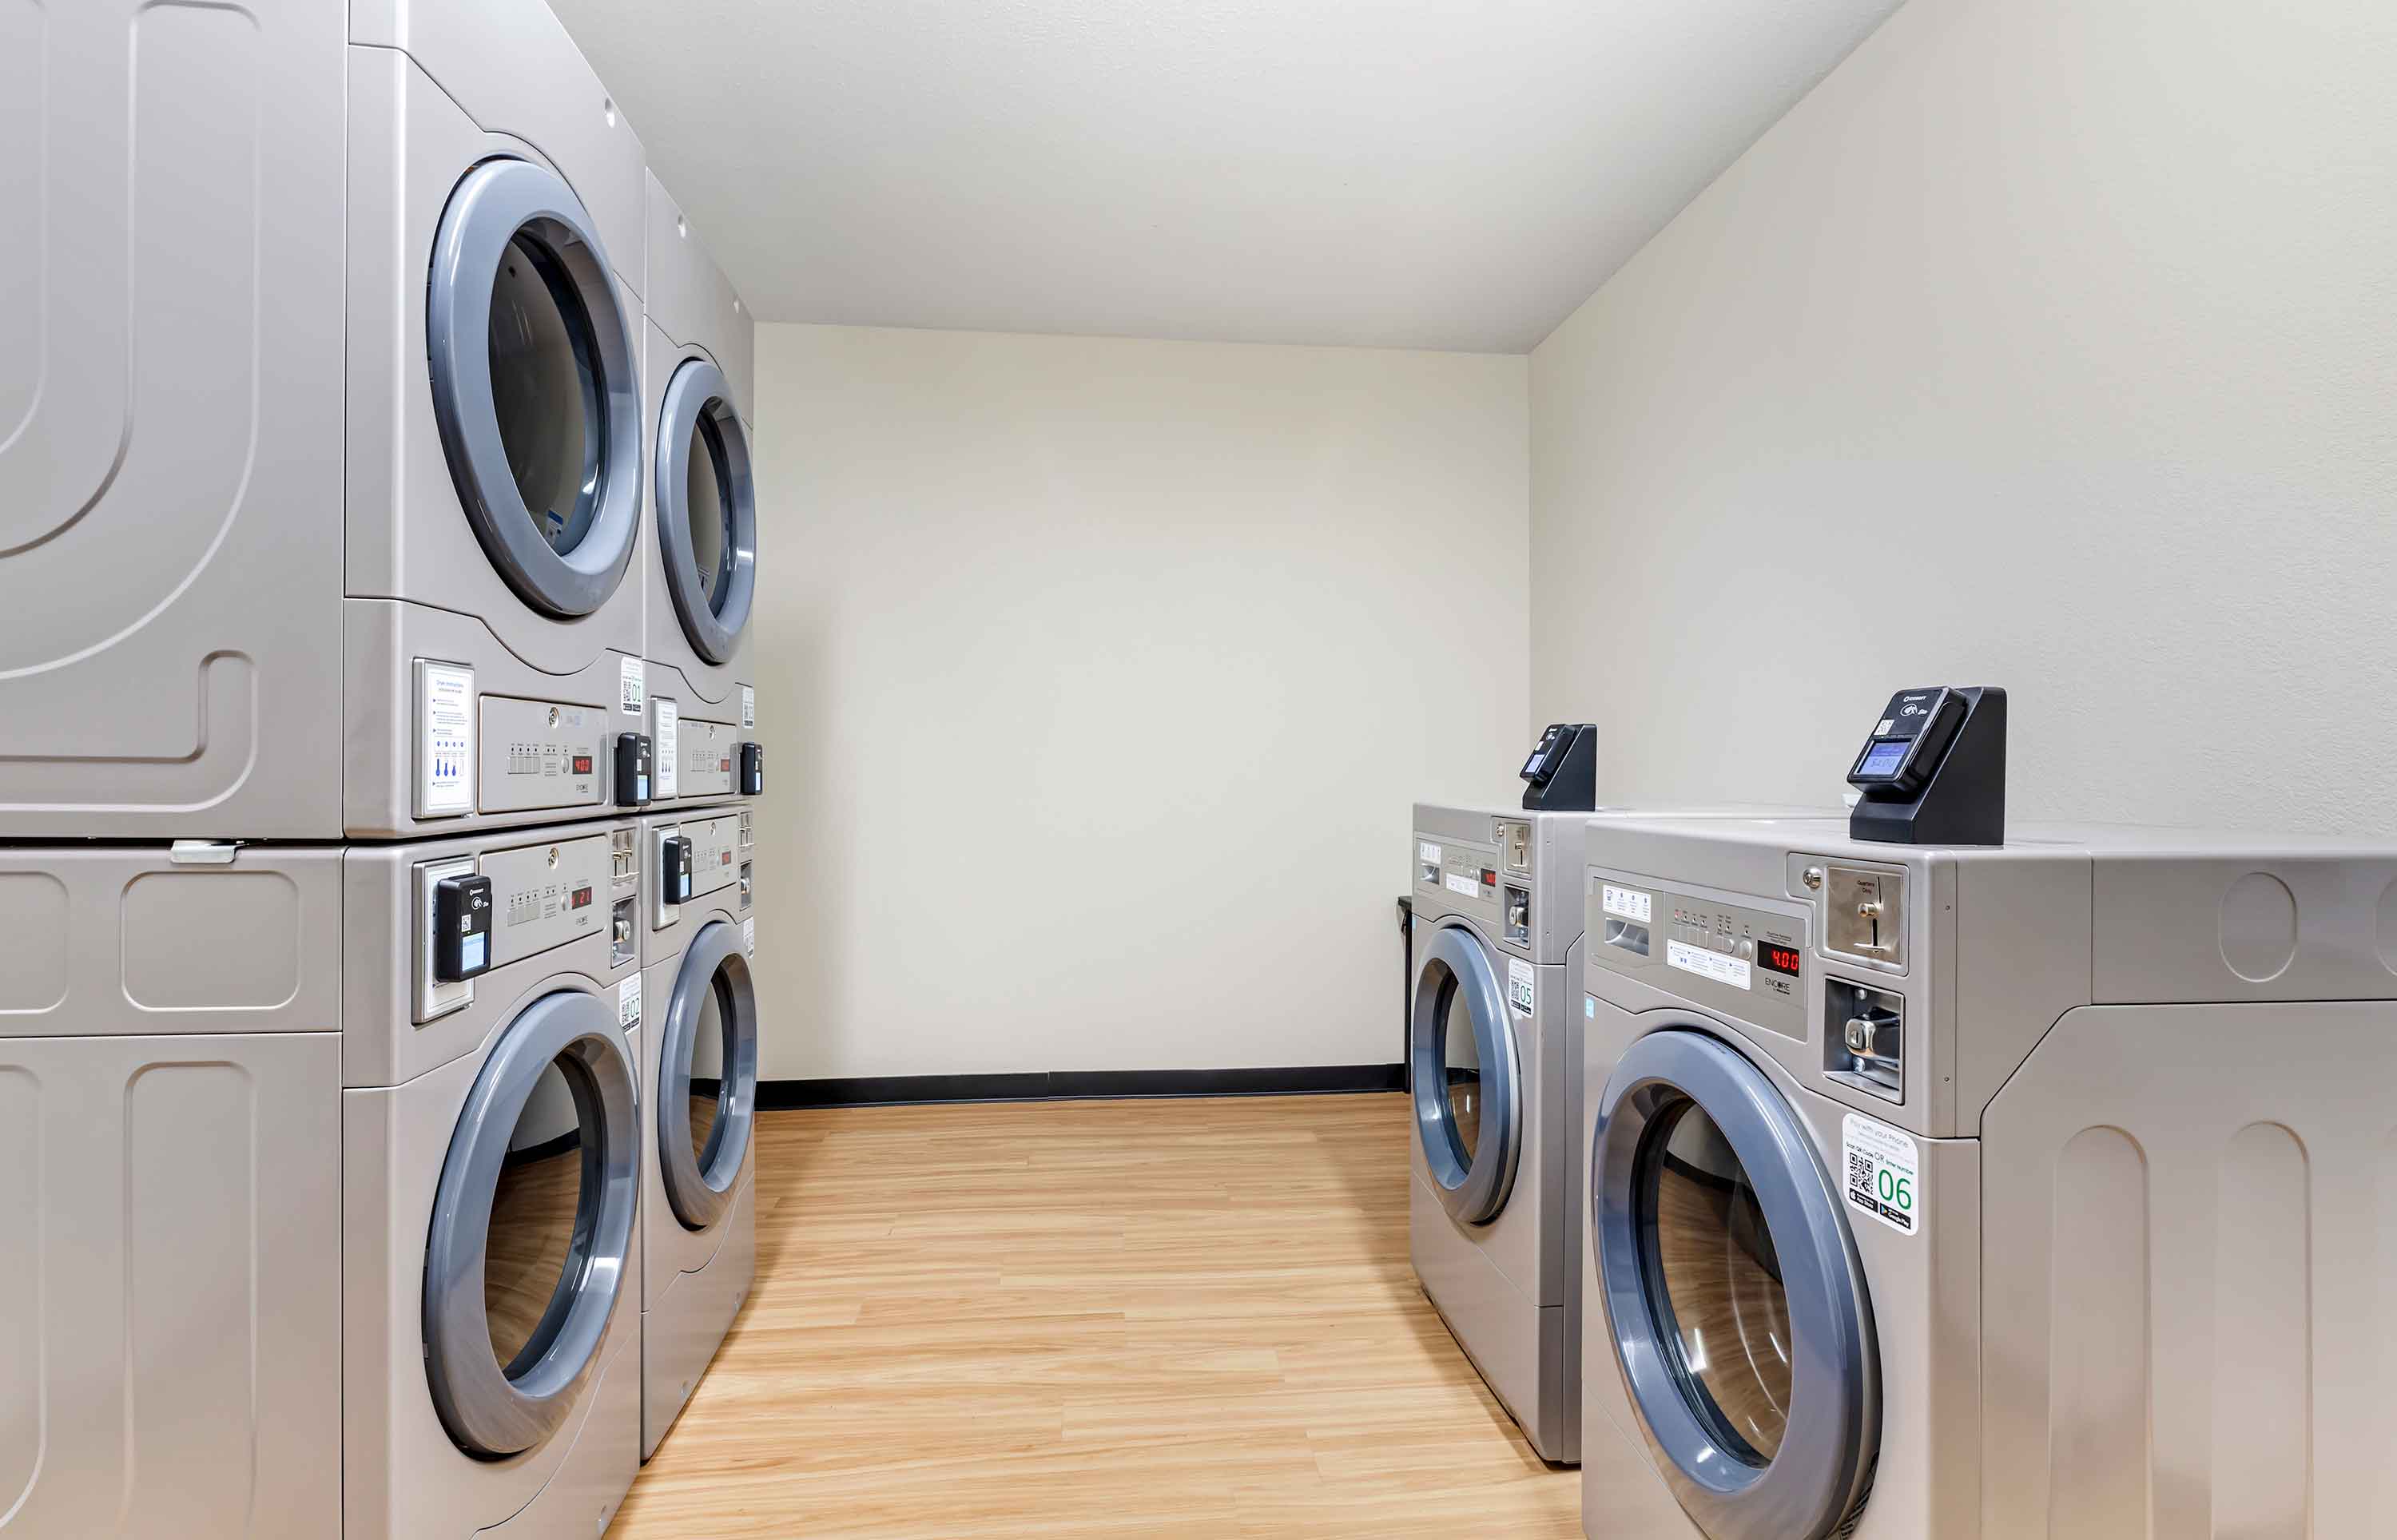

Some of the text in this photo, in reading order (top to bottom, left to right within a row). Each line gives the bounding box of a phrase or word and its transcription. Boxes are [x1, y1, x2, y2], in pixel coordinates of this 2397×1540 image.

[1771, 950, 1799, 970] 4.00
[1520, 985, 1532, 1005] 05
[1874, 1152, 1885, 1163] OR
[1878, 1169, 1912, 1210] 06
